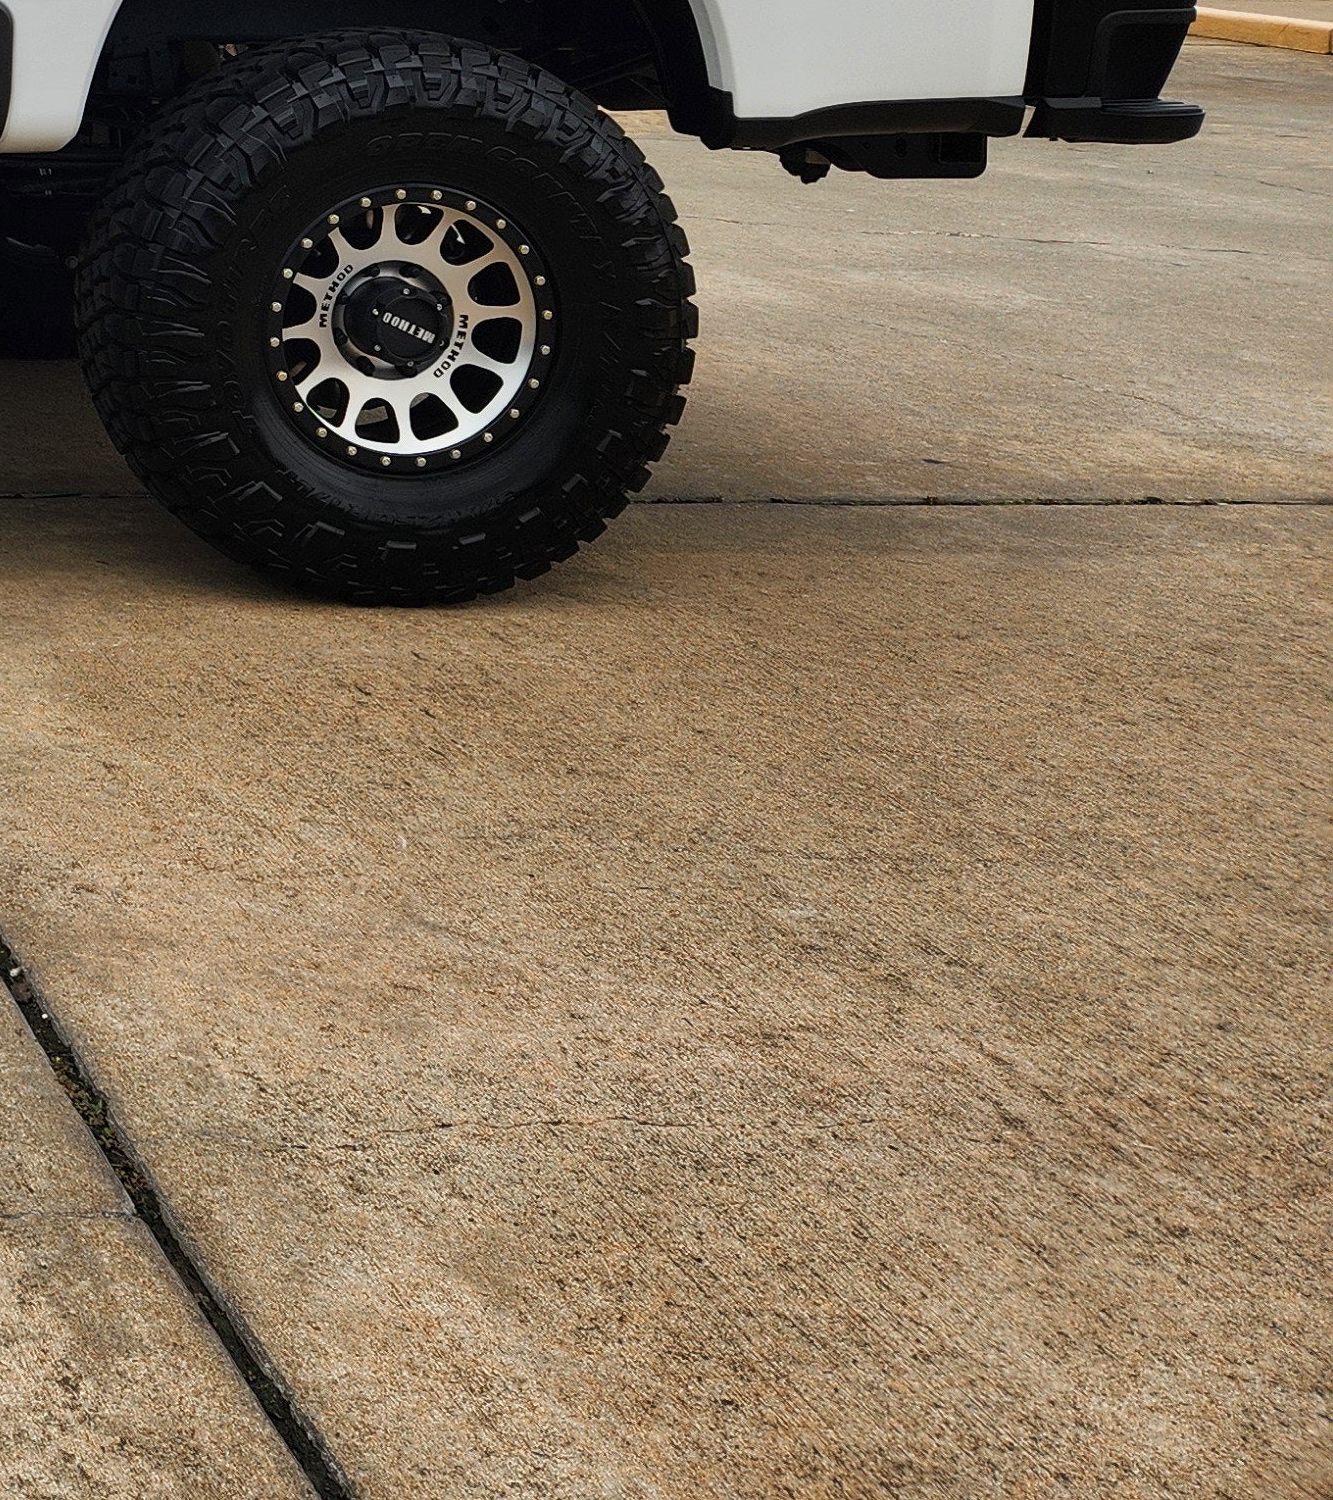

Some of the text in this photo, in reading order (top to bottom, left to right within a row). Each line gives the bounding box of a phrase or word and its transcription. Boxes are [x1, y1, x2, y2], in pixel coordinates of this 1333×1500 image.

[319, 264, 354, 328] METHOD
[383, 311, 436, 344] METHOD
[433, 314, 469, 379] METHOD
